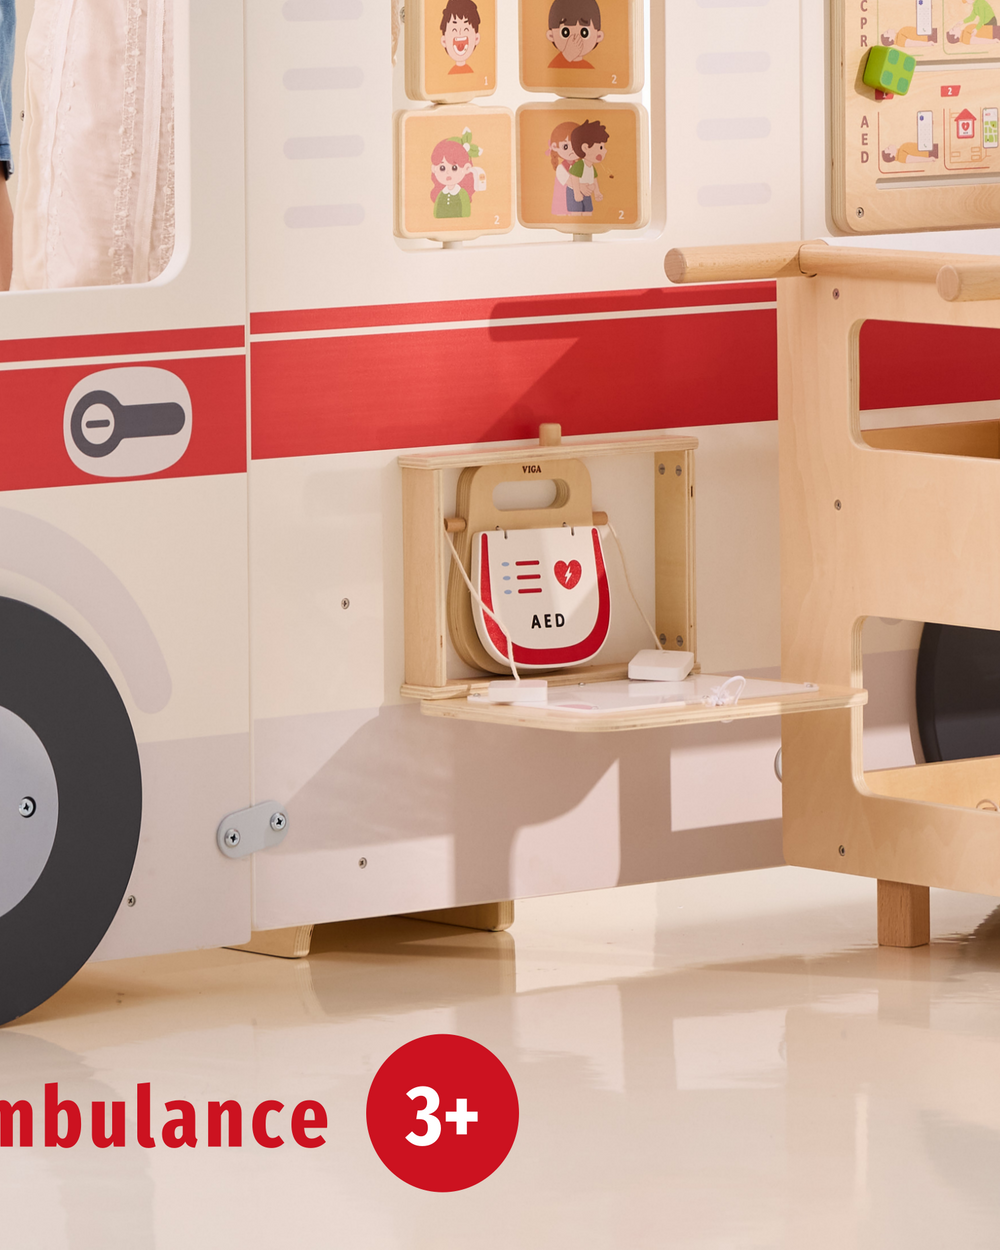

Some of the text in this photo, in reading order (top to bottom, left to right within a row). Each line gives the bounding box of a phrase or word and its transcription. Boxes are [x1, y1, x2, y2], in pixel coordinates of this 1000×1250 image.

[484, 76, 489, 86] 1
[611, 74, 618, 84] 2
[947, 87, 953, 96] 2
[618, 209, 625, 220] 2
[493, 215, 500, 225] 2
[522, 465, 542, 474] VIGA
[530, 612, 566, 630] AED
